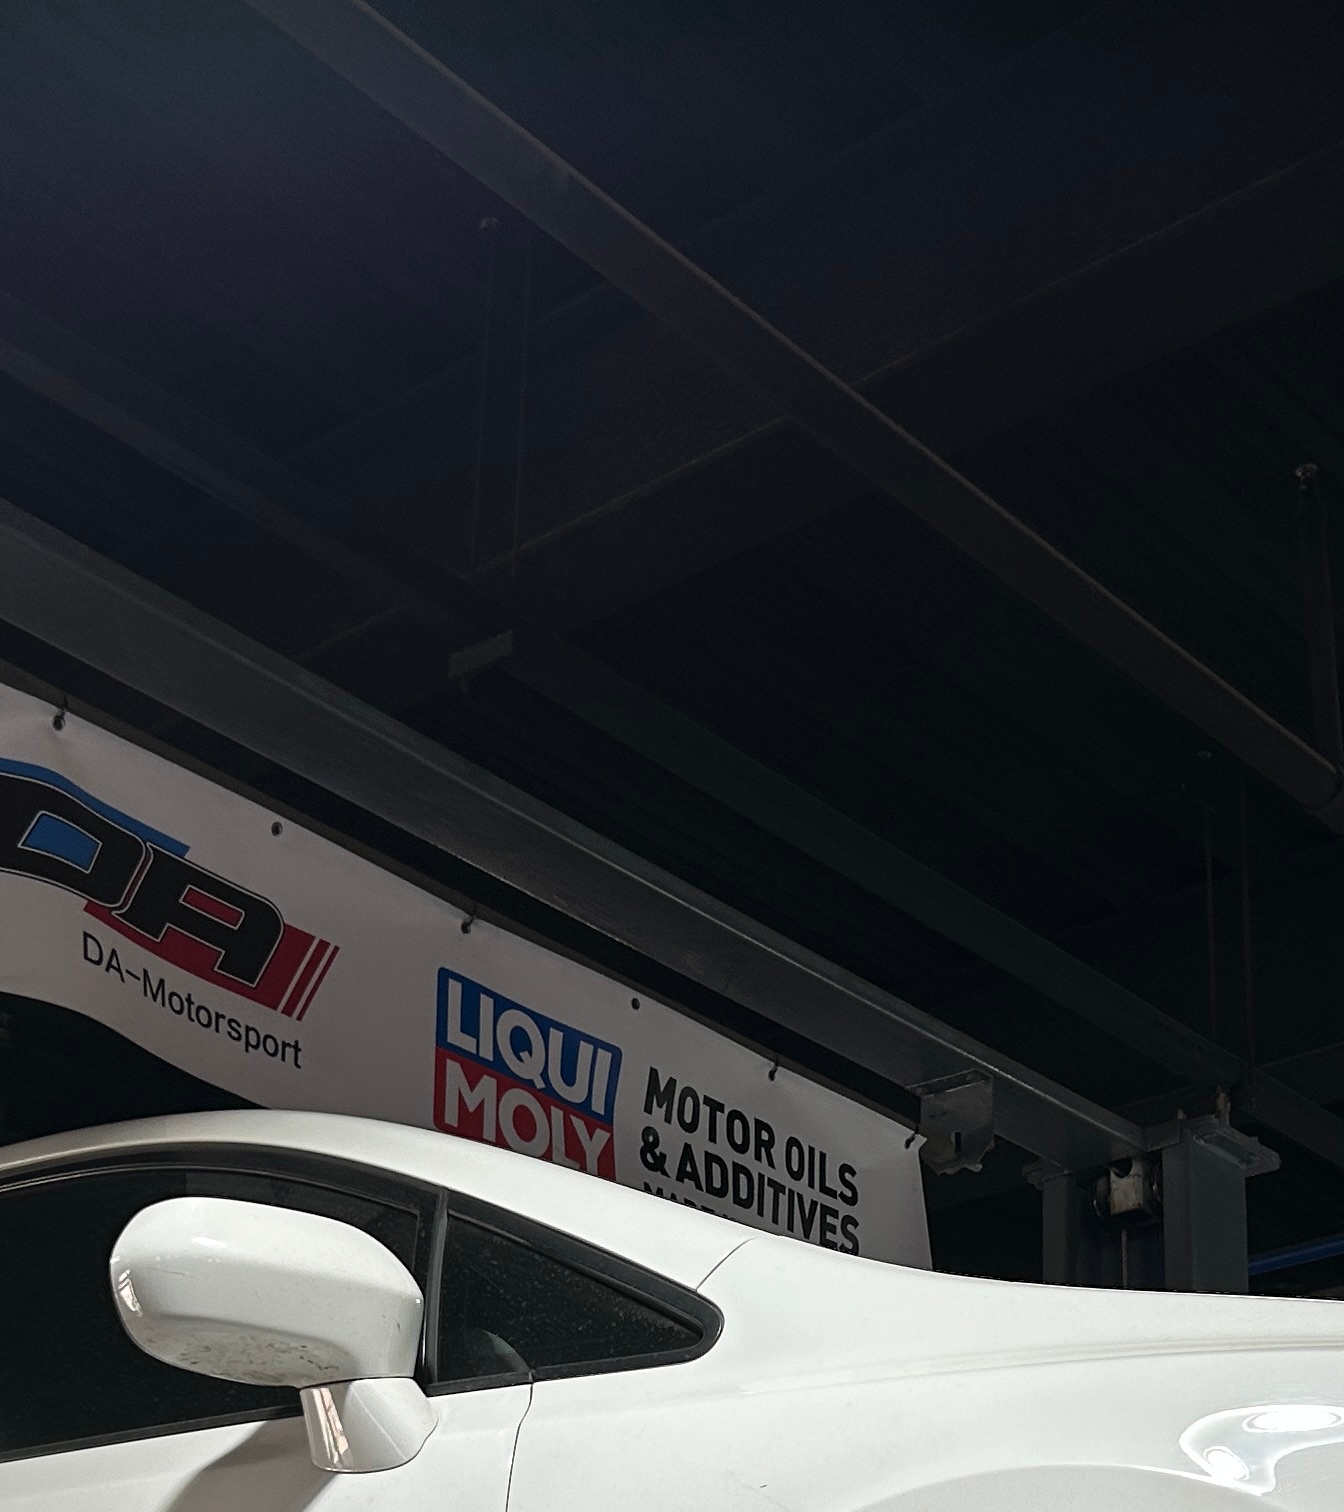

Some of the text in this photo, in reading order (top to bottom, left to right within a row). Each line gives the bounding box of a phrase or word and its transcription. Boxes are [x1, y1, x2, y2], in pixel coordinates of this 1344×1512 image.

[81, 929, 303, 1070] DA-Motorsport
[446, 978, 613, 1116] LIQUI
[444, 1059, 613, 1178] MOLY
[643, 1066, 775, 1169] MOTOR
[784, 1136, 859, 1207] OILS
[639, 1126, 672, 1178] &
[675, 1143, 859, 1256] ADDITIVES
